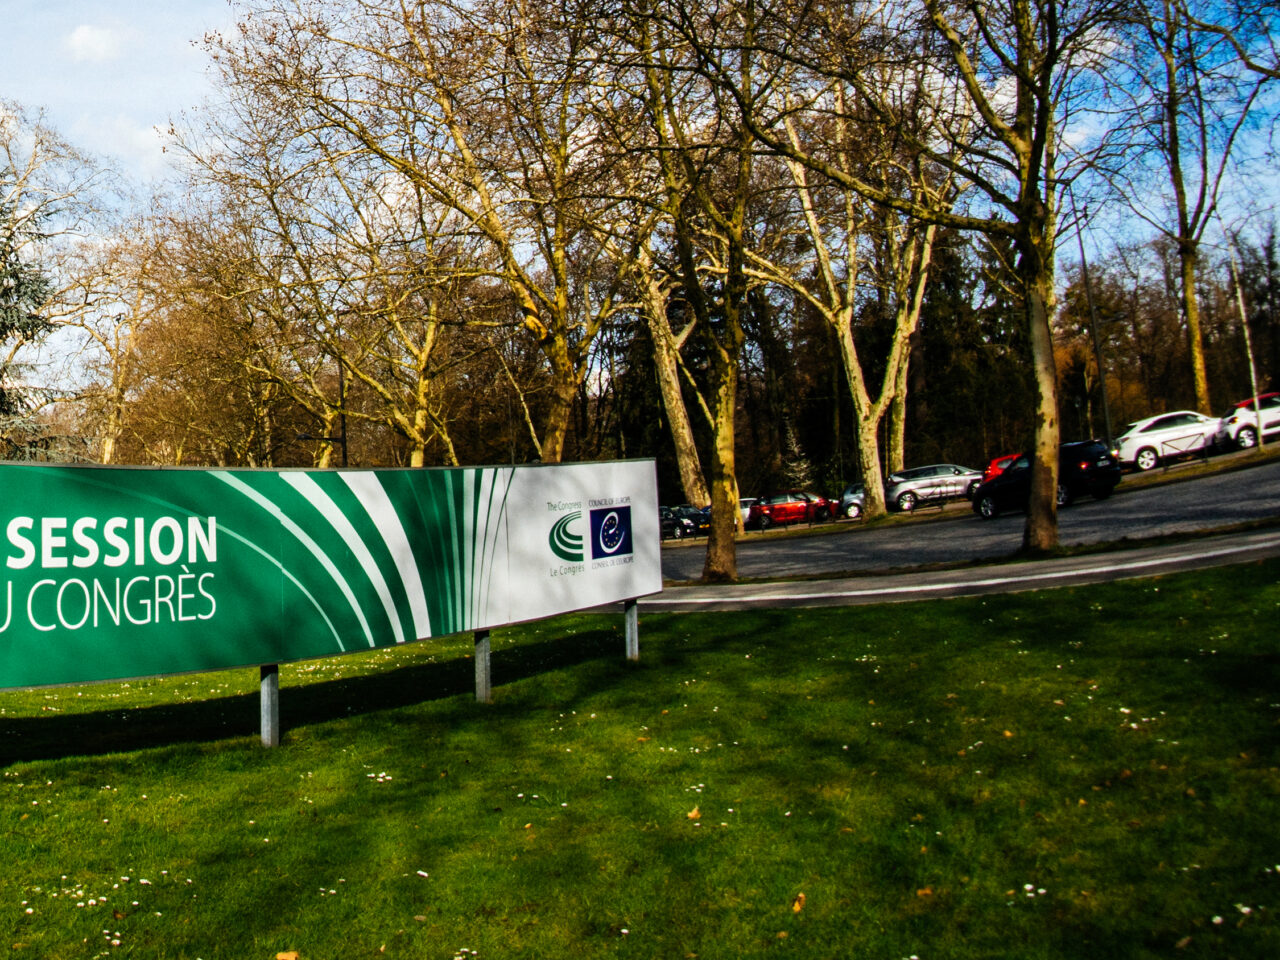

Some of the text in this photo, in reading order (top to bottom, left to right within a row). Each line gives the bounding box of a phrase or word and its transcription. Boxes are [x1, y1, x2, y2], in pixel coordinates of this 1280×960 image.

[547, 500, 582, 512] The Congress
[6, 516, 217, 570] SESSION
[549, 567, 558, 577] Le
[26, 564, 217, 632] CONGRÈS
